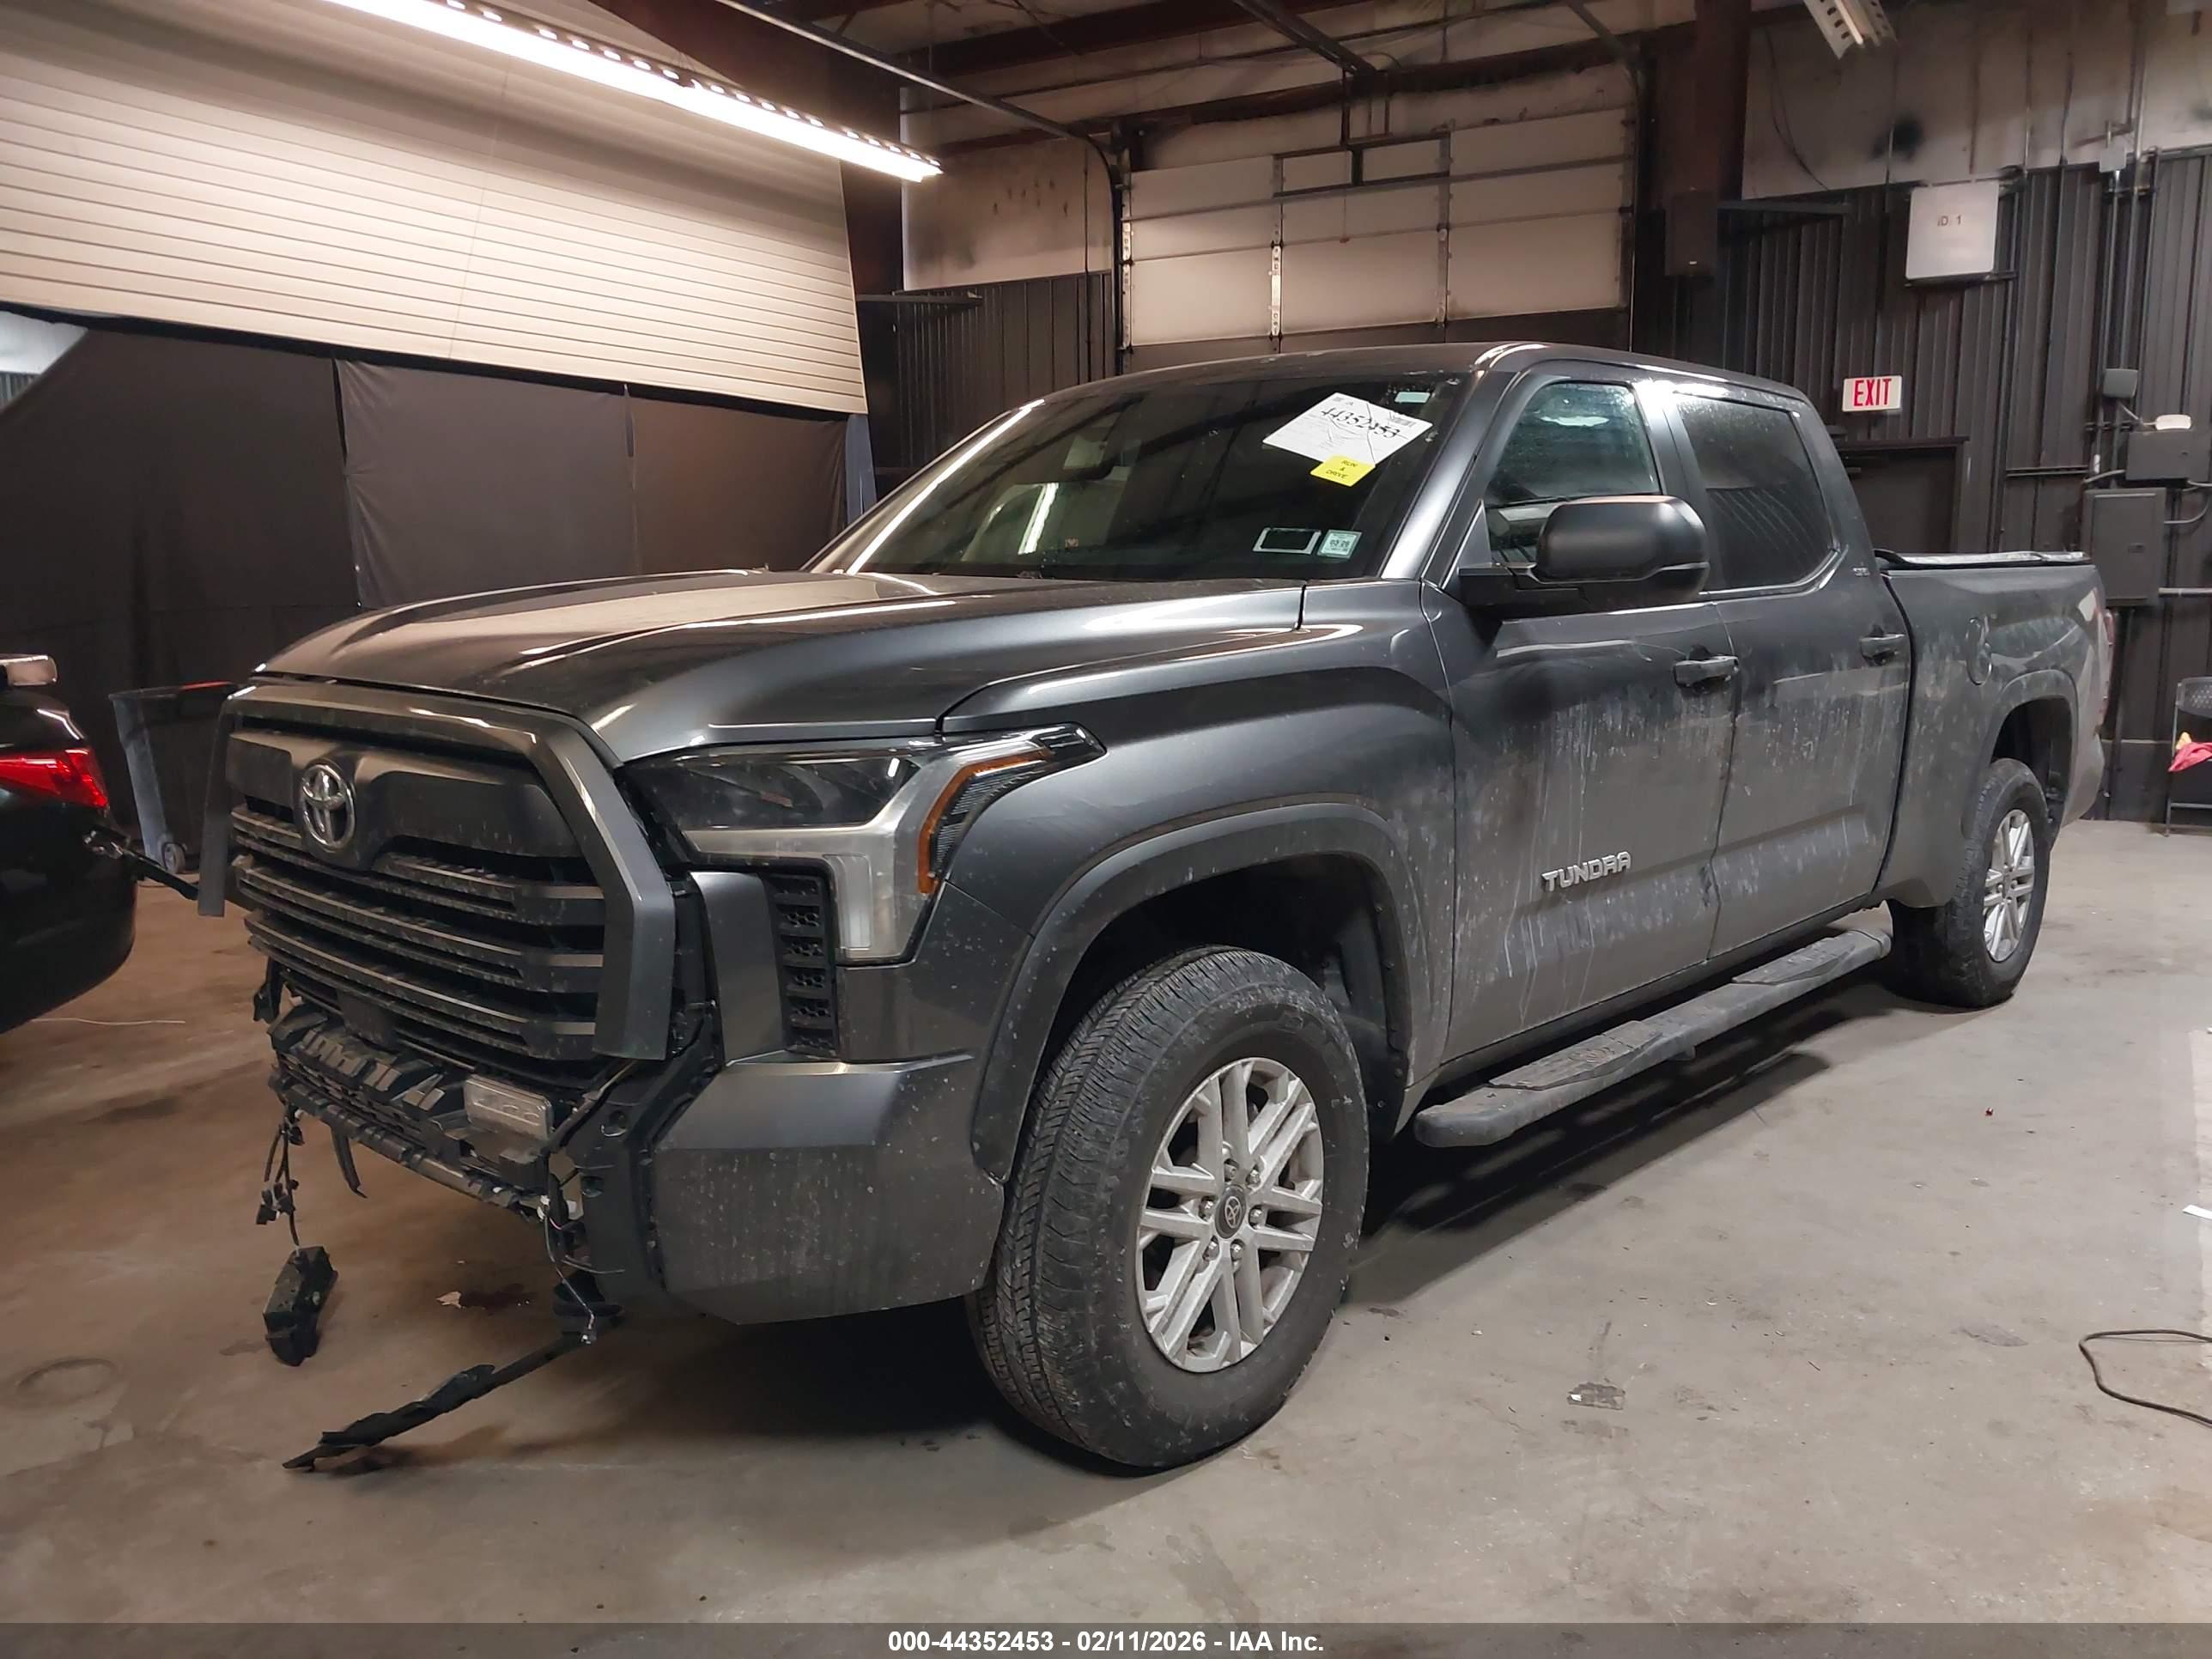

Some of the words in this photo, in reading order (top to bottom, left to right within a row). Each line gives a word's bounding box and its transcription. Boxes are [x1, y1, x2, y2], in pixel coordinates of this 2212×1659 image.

[1853, 378, 1893, 407] EXIT
[1340, 459, 1358, 468] RUN
[1325, 469, 1349, 479] DRIVE
[1540, 850, 1632, 892] TUNDRA
